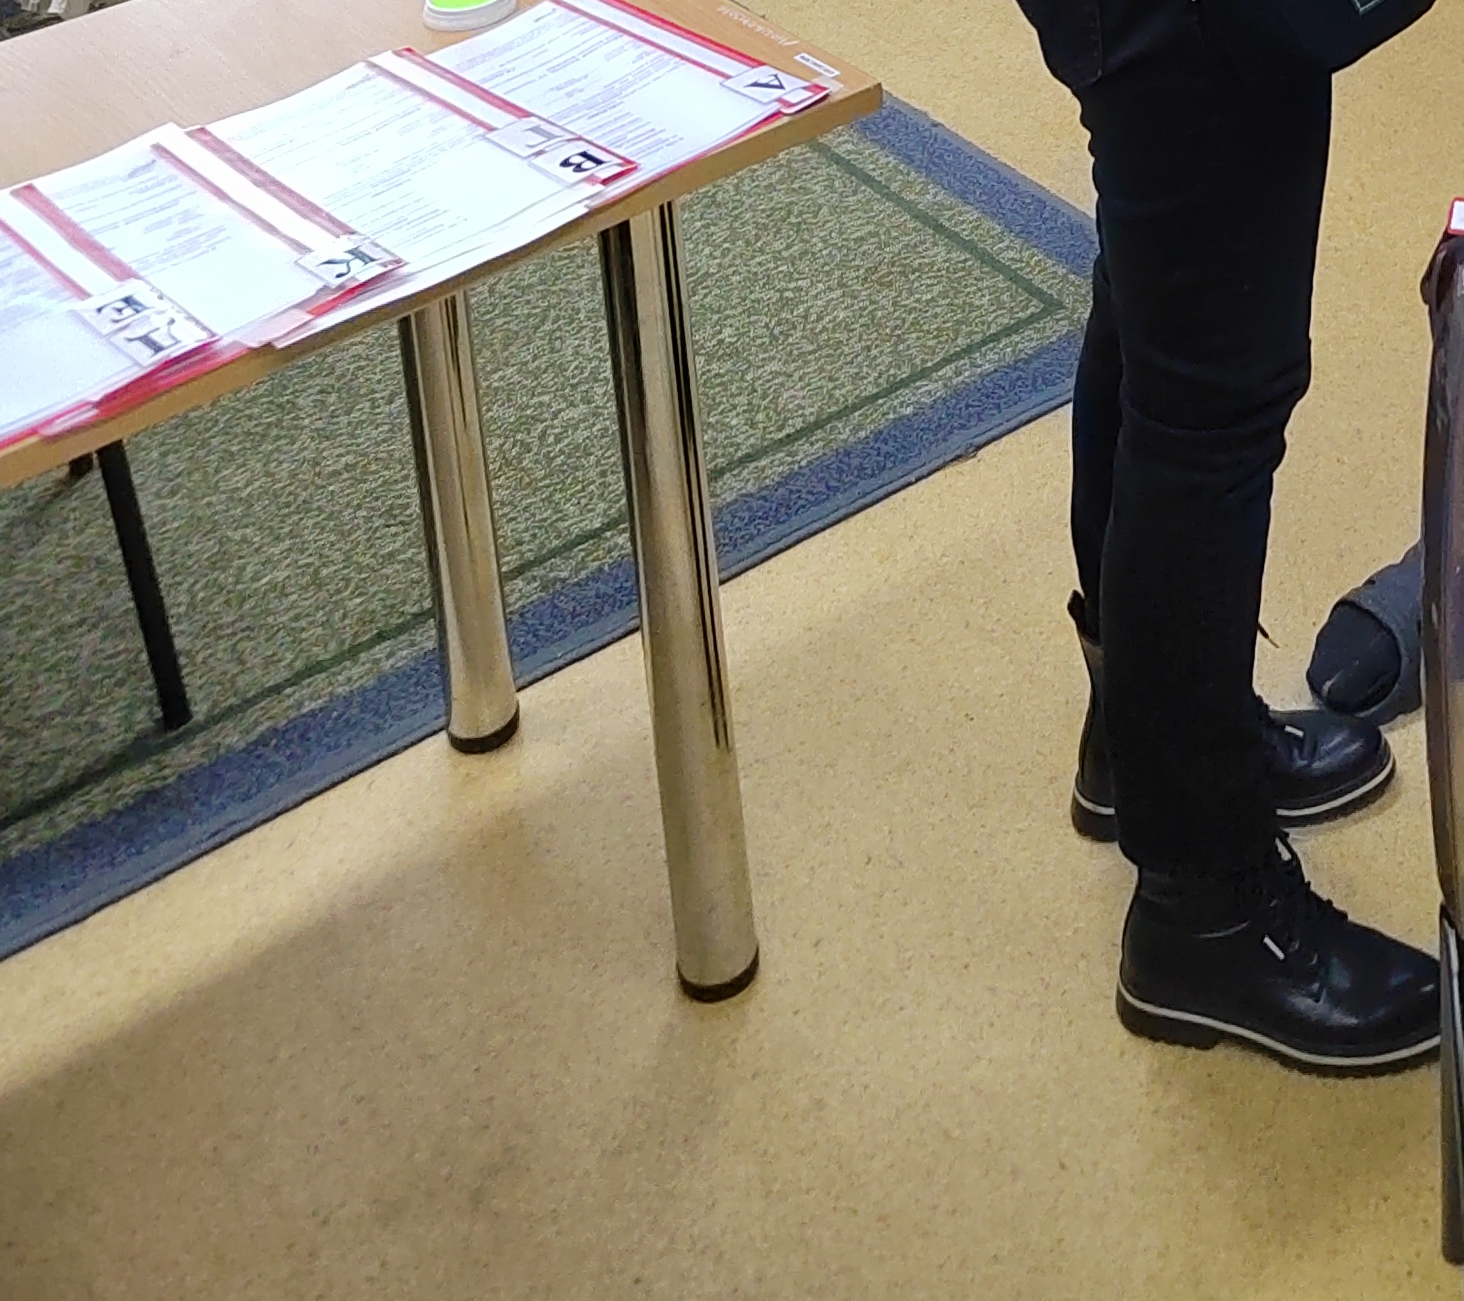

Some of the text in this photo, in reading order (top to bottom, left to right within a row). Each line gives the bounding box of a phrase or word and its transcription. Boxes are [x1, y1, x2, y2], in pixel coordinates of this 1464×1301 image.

[743, 73, 786, 90] А
[559, 150, 612, 173] В
[316, 245, 382, 278] К
